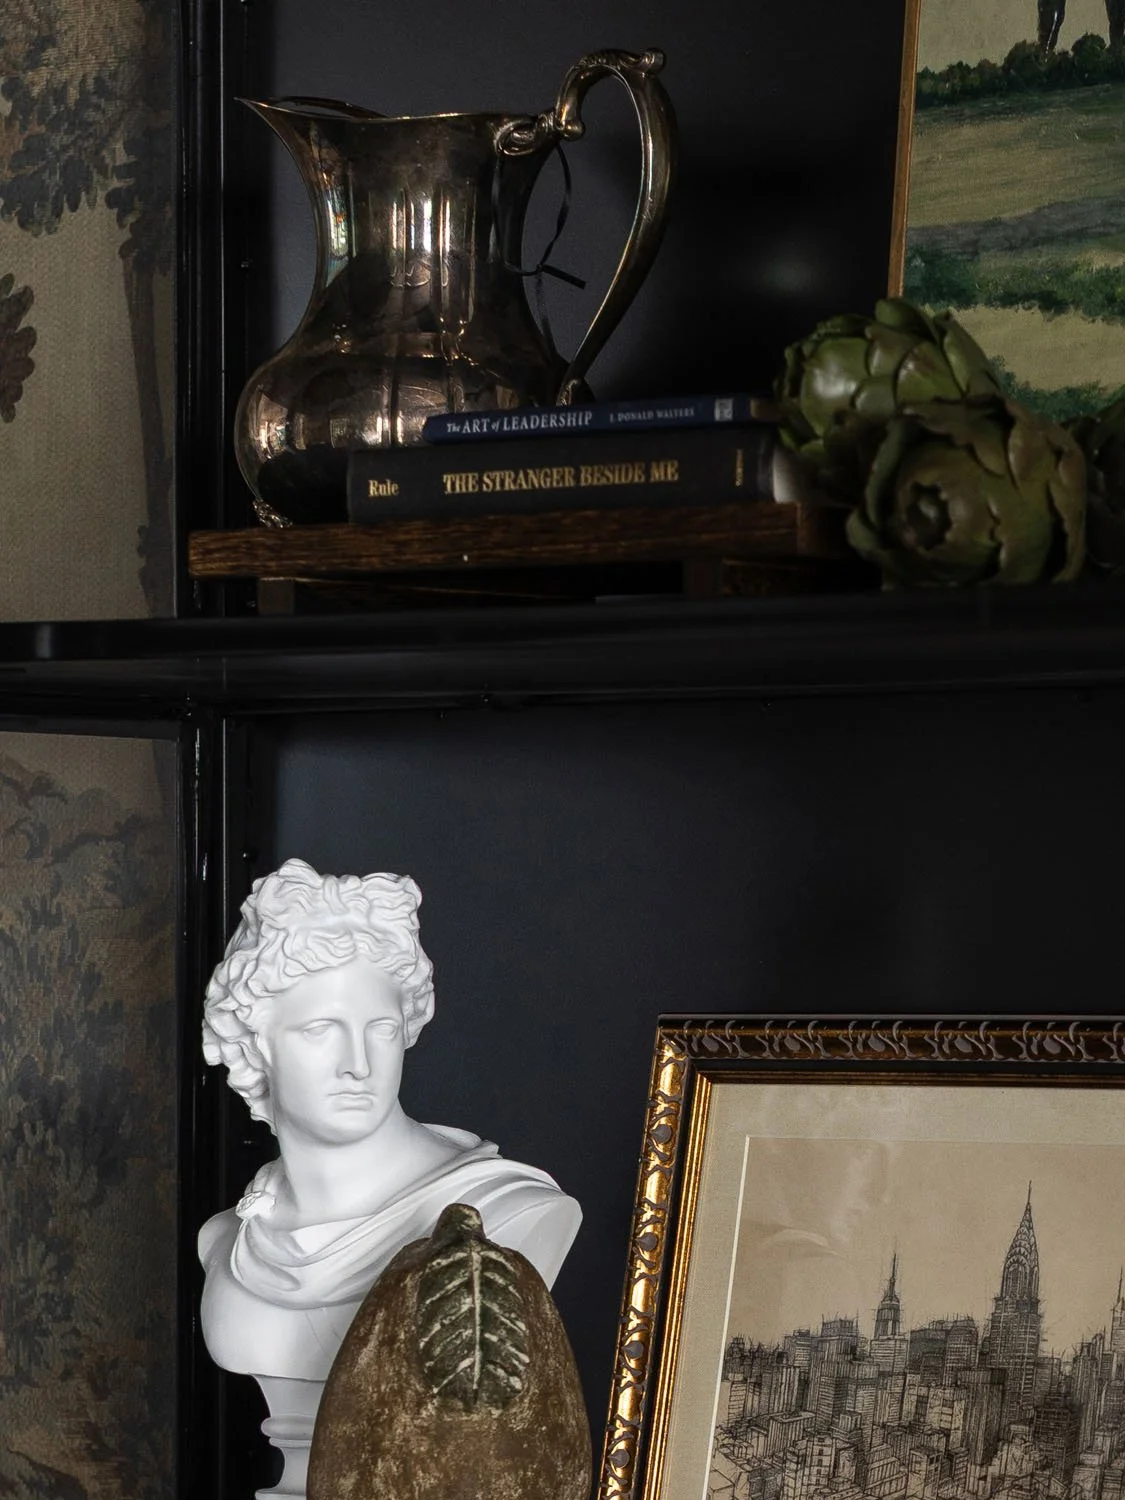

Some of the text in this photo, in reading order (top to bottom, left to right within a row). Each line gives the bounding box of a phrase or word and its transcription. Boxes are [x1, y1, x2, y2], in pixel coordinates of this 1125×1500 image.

[446, 410, 593, 434] The ART of LEADERSHIP
[368, 479, 400, 498] Rule
[443, 459, 679, 494] THE STRANGER BESIDE ME
